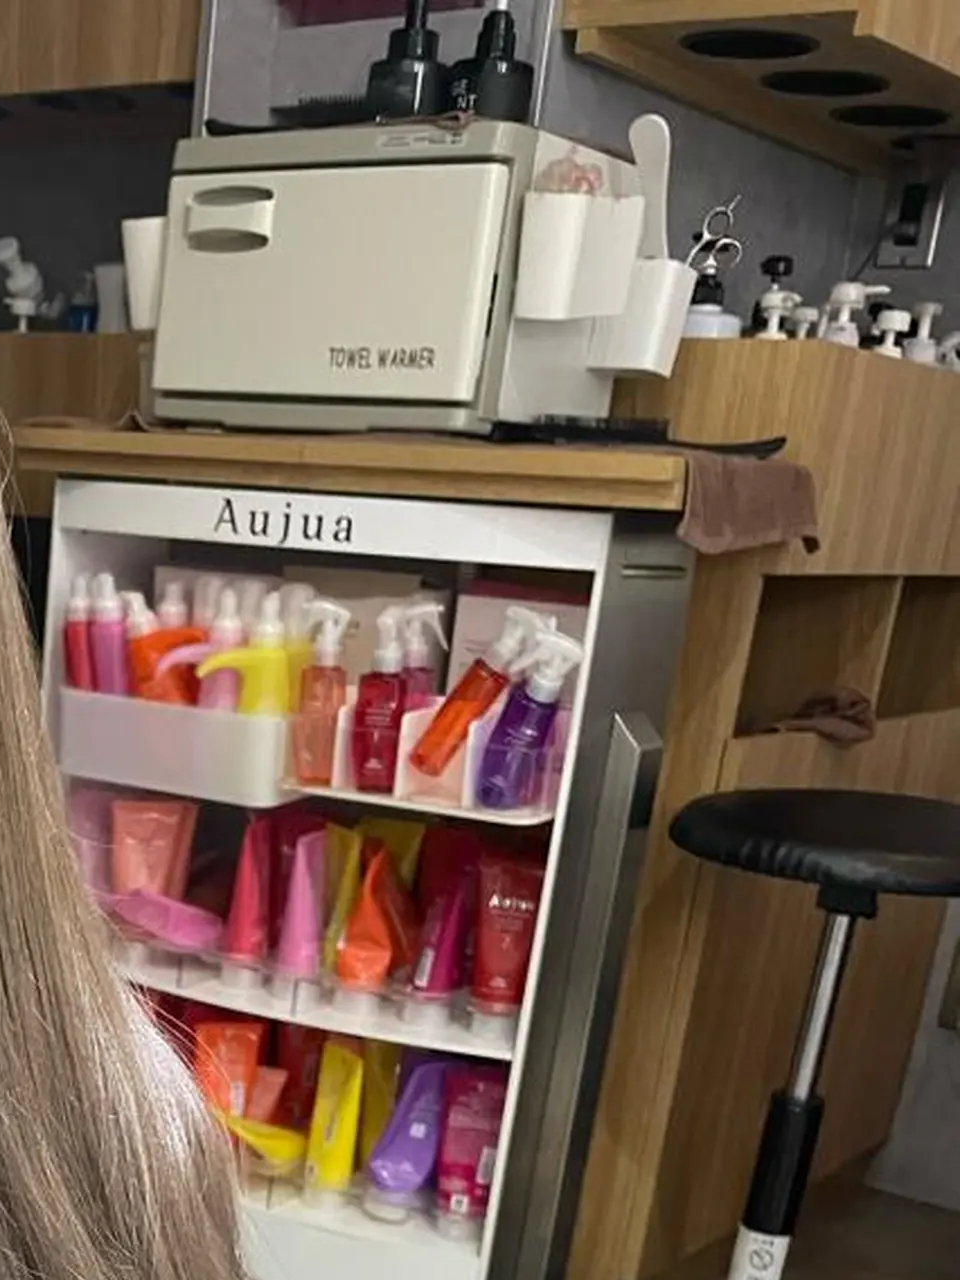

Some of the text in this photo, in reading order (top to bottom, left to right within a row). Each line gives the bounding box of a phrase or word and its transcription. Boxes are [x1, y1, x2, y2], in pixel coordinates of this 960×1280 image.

[329, 346, 435, 370] TOWEL WARMER
[214, 497, 353, 545] Aujua
